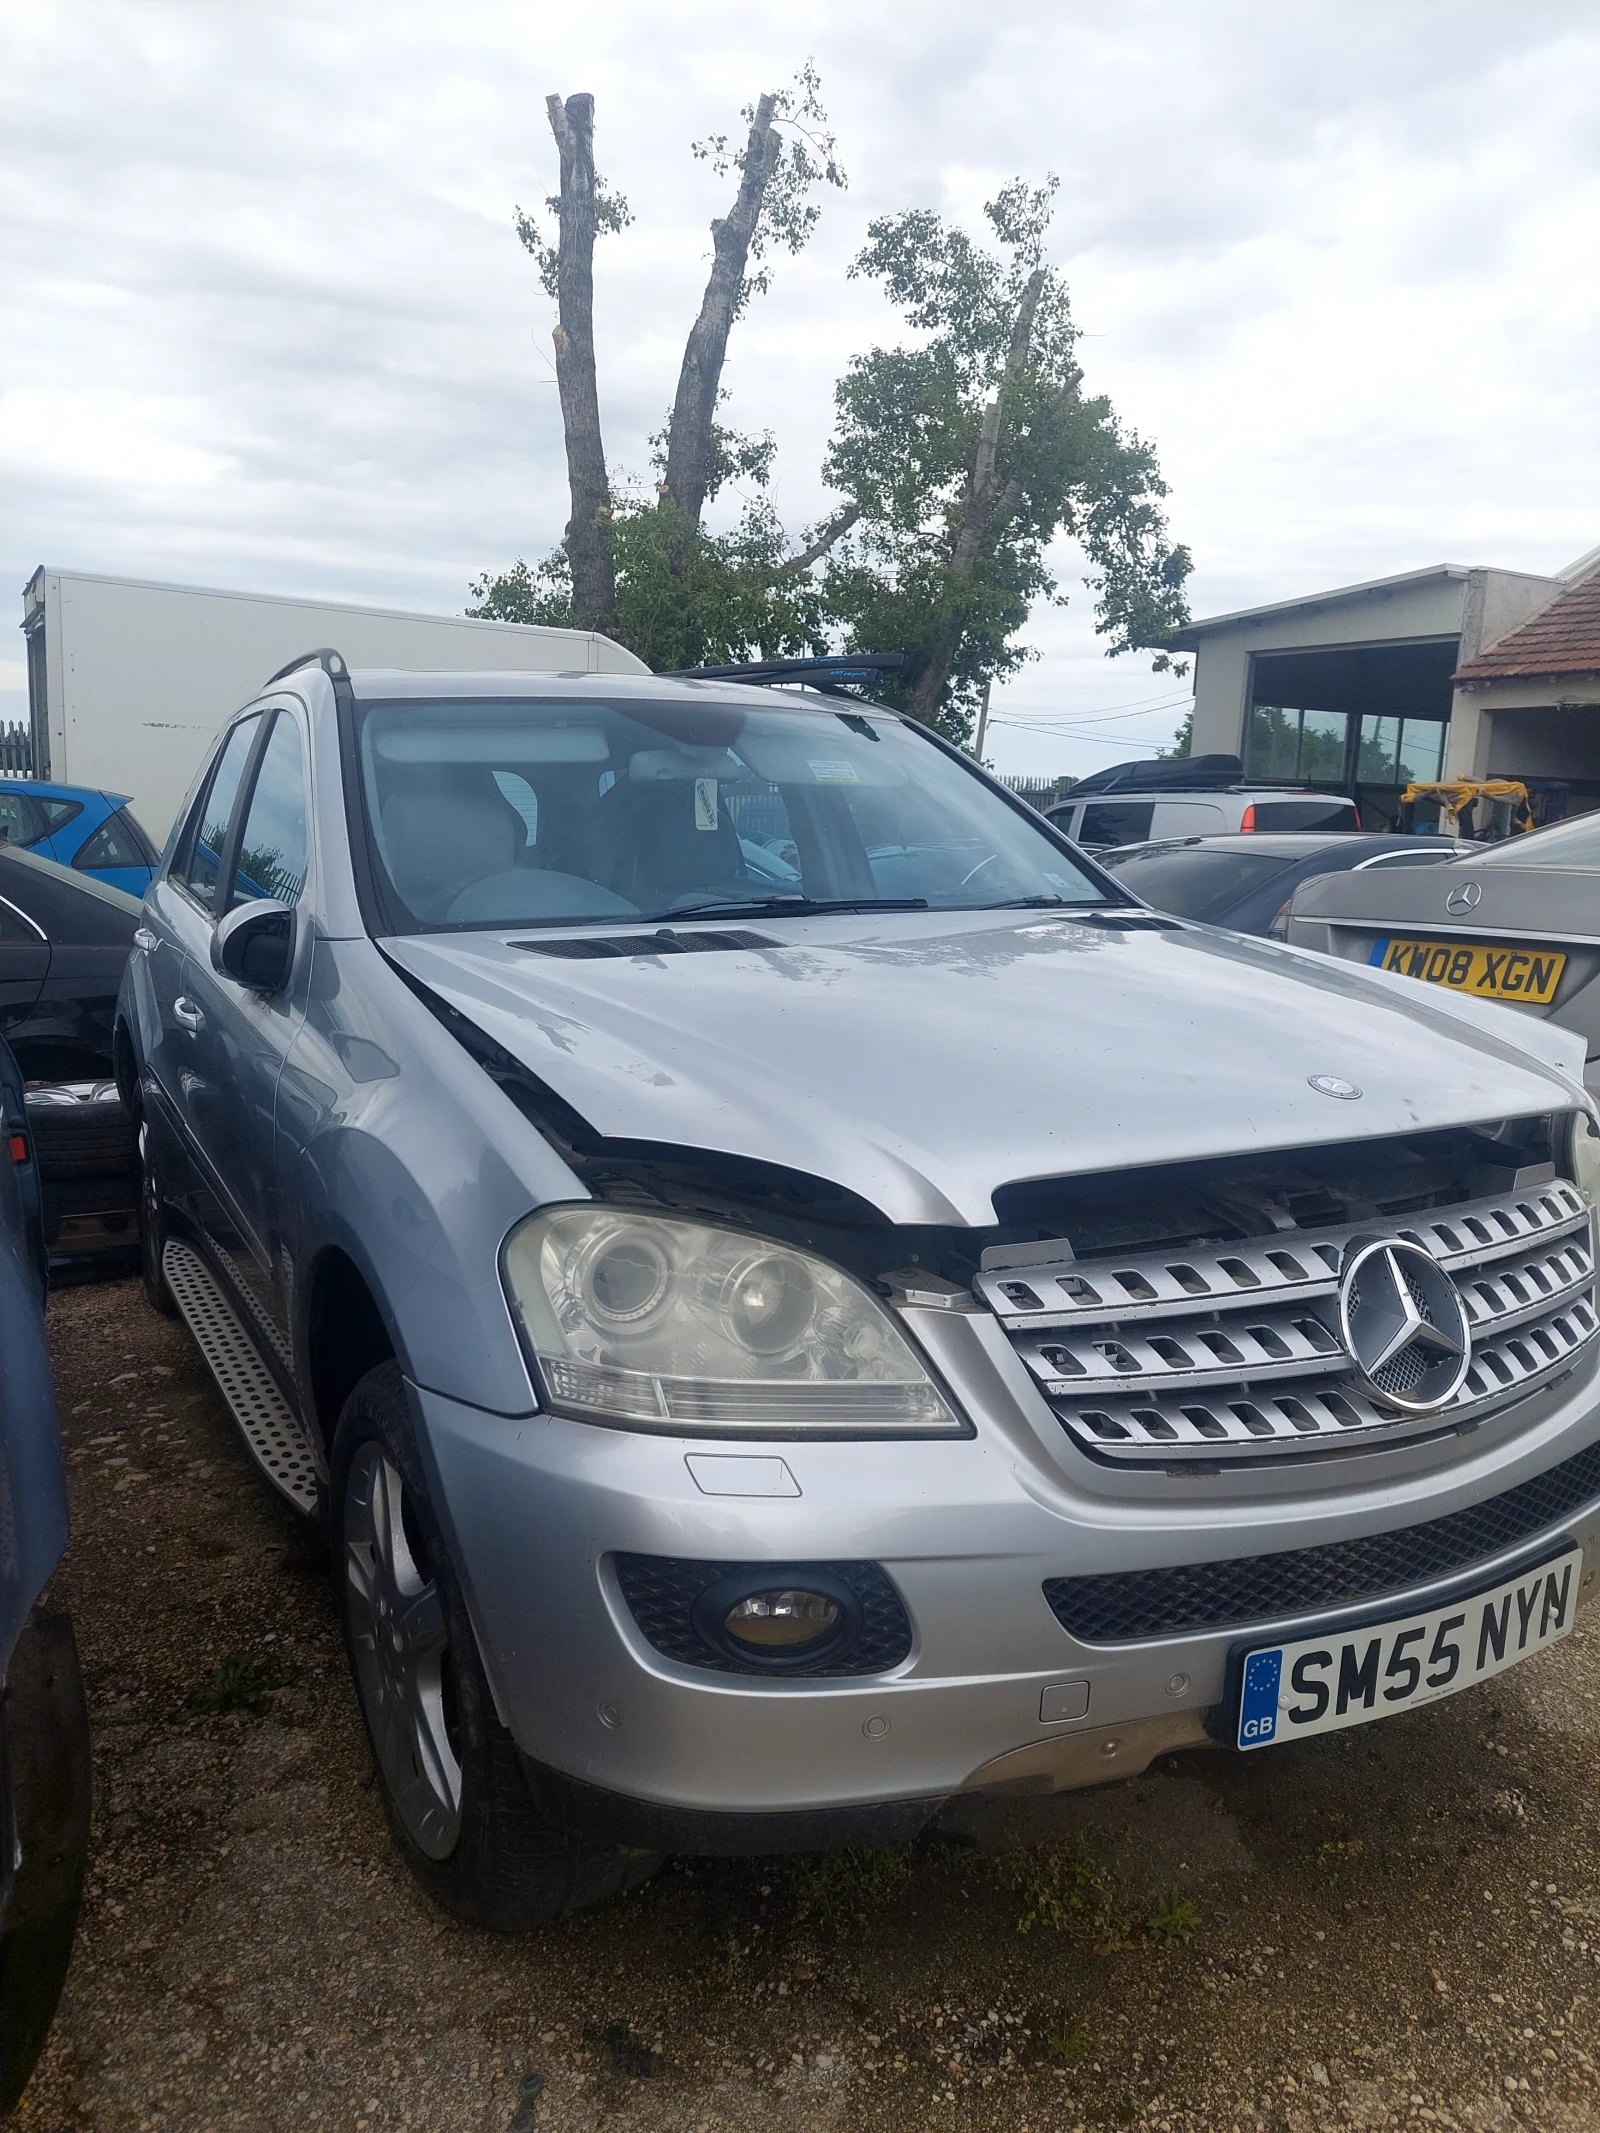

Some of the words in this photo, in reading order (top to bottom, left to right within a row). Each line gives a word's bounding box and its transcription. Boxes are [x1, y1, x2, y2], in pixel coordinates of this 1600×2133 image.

[1388, 945, 1473, 985] KW08
[1476, 953, 1556, 995] XGN
[1287, 1613, 1466, 1725] SM55
[1476, 1563, 1573, 1671] NYN
[1243, 1716, 1273, 1739] GB
